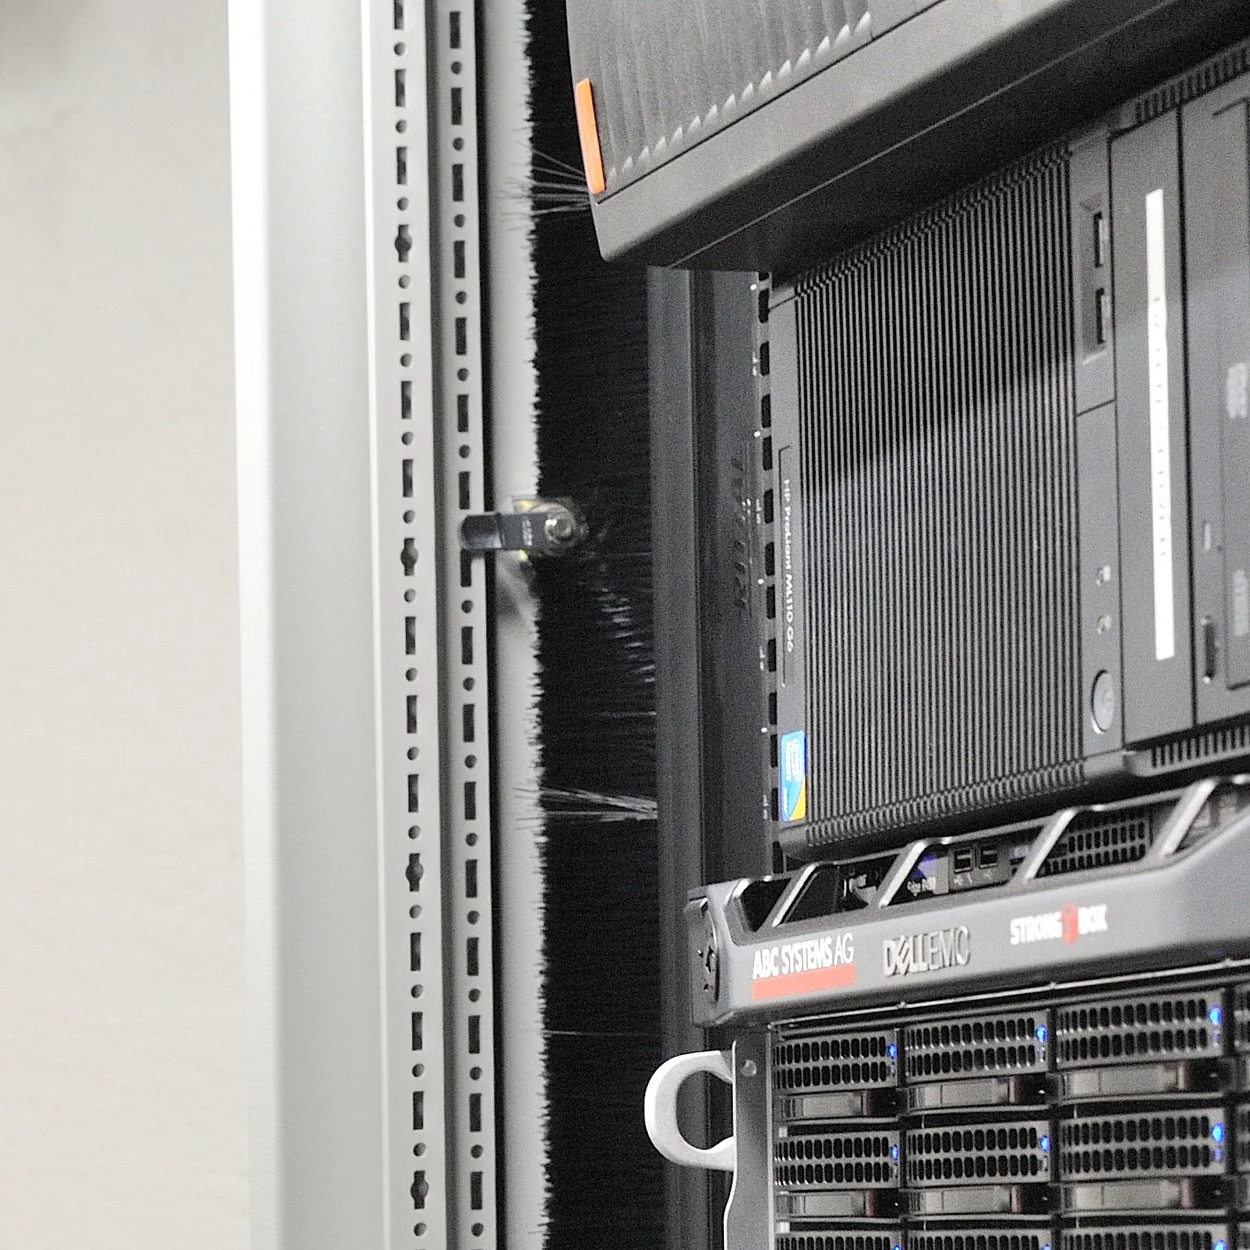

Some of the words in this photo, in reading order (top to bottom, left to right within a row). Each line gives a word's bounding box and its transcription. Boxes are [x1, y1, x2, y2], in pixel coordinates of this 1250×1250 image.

[752, 950, 781, 980] ABC
[781, 936, 833, 974] SYSTEMS
[833, 932, 855, 966] AG
